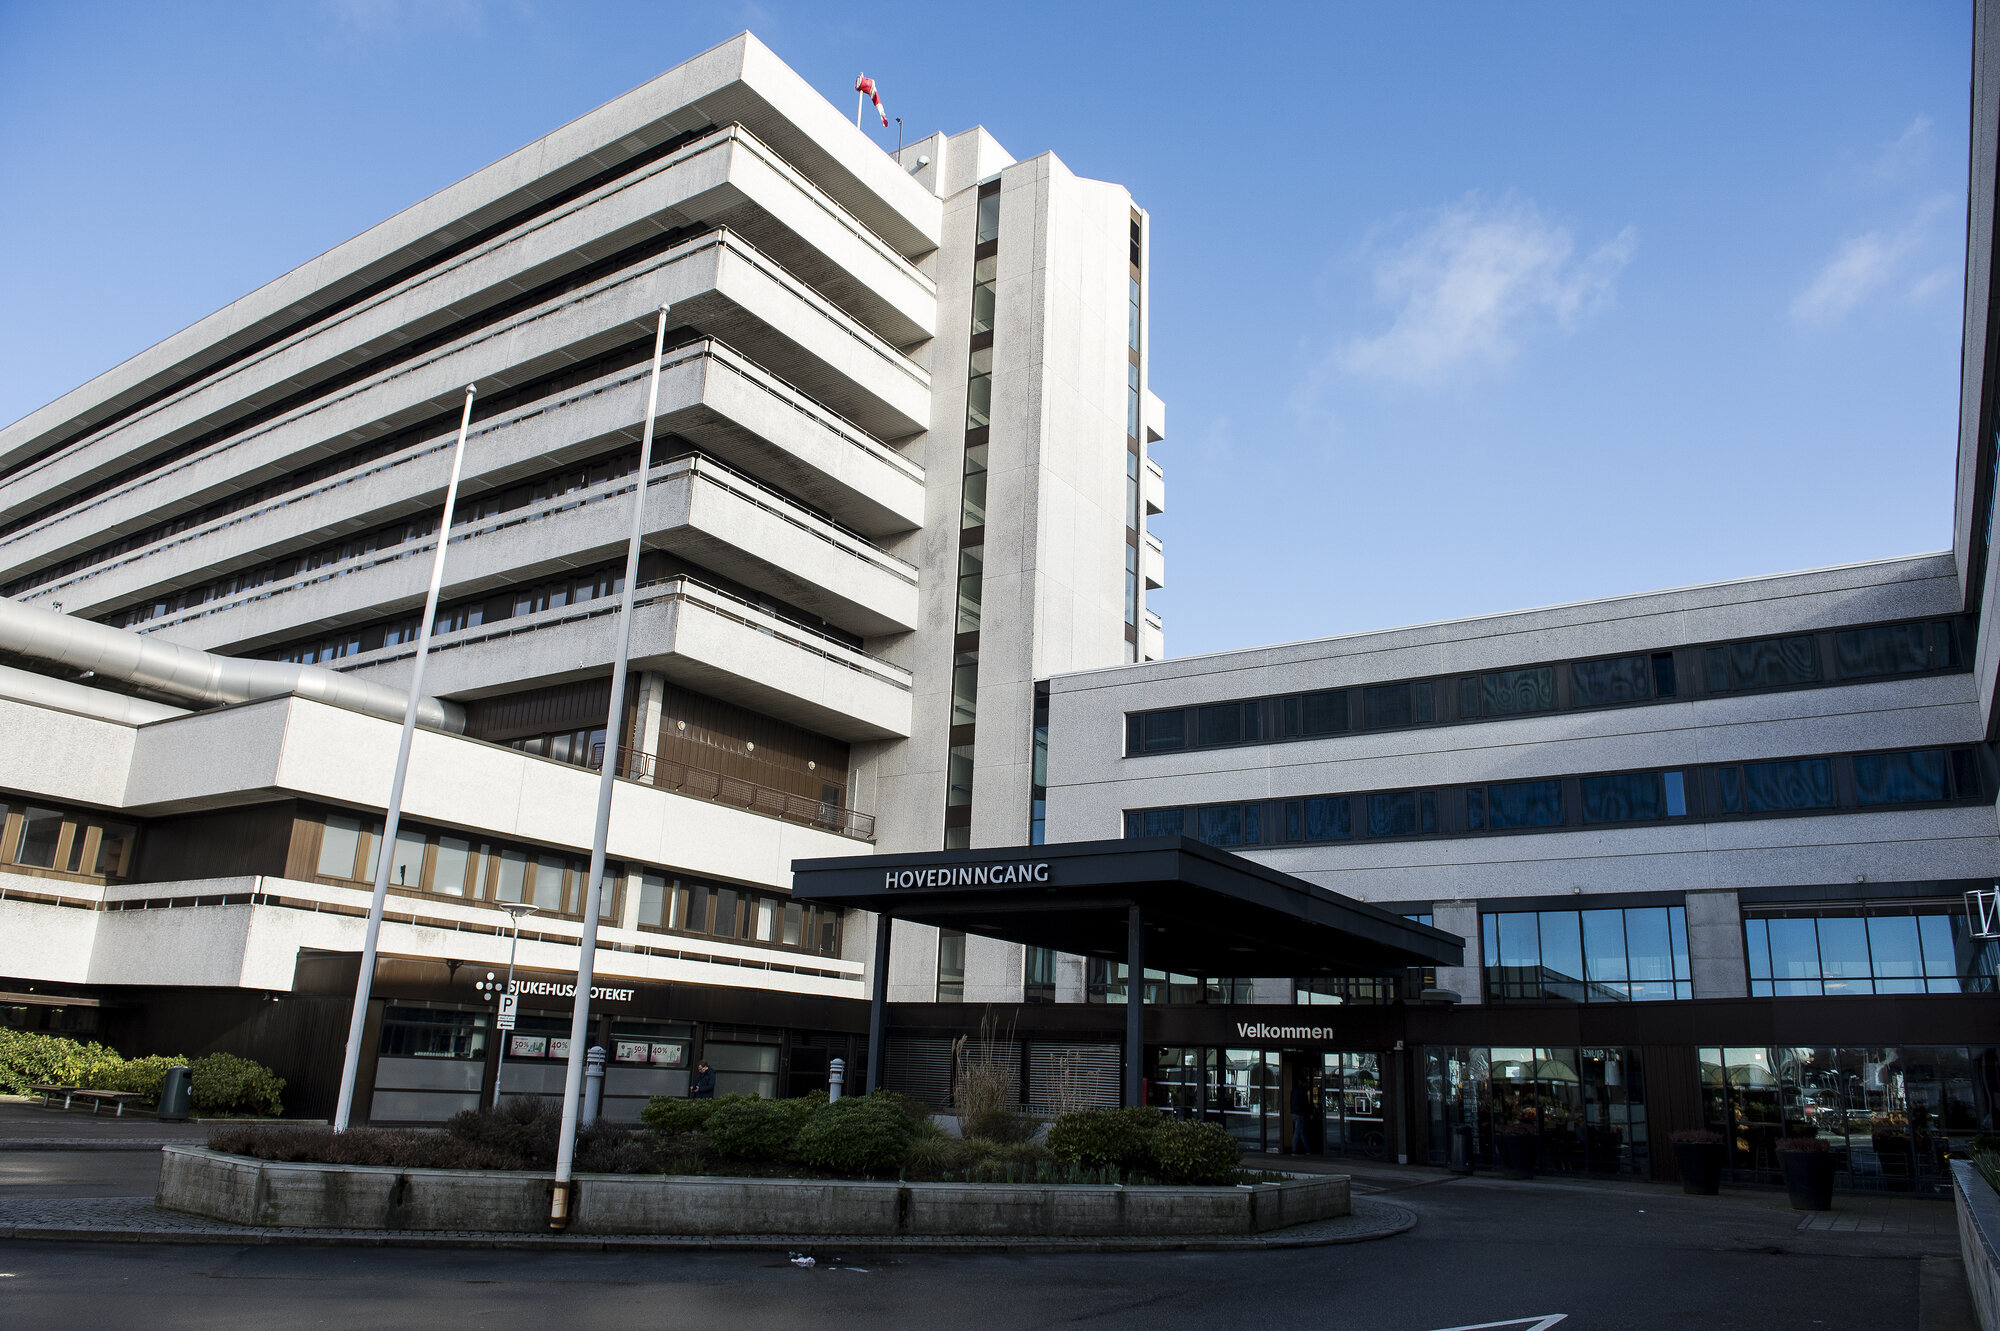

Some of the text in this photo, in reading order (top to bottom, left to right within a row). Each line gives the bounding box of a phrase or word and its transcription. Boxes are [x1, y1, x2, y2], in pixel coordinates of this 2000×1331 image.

[885, 863, 1049, 889] HOVEDINNGANG
[509, 980, 634, 1002] SJUKEHUSOTEKET
[503, 997, 513, 1013] P
[1237, 1022, 1334, 1040] Velkommen
[515, 1041, 529, 1050] 50%
[552, 1041, 568, 1050] 40%
[634, 1045, 647, 1054] 50%
[652, 1047, 668, 1056] 40%
